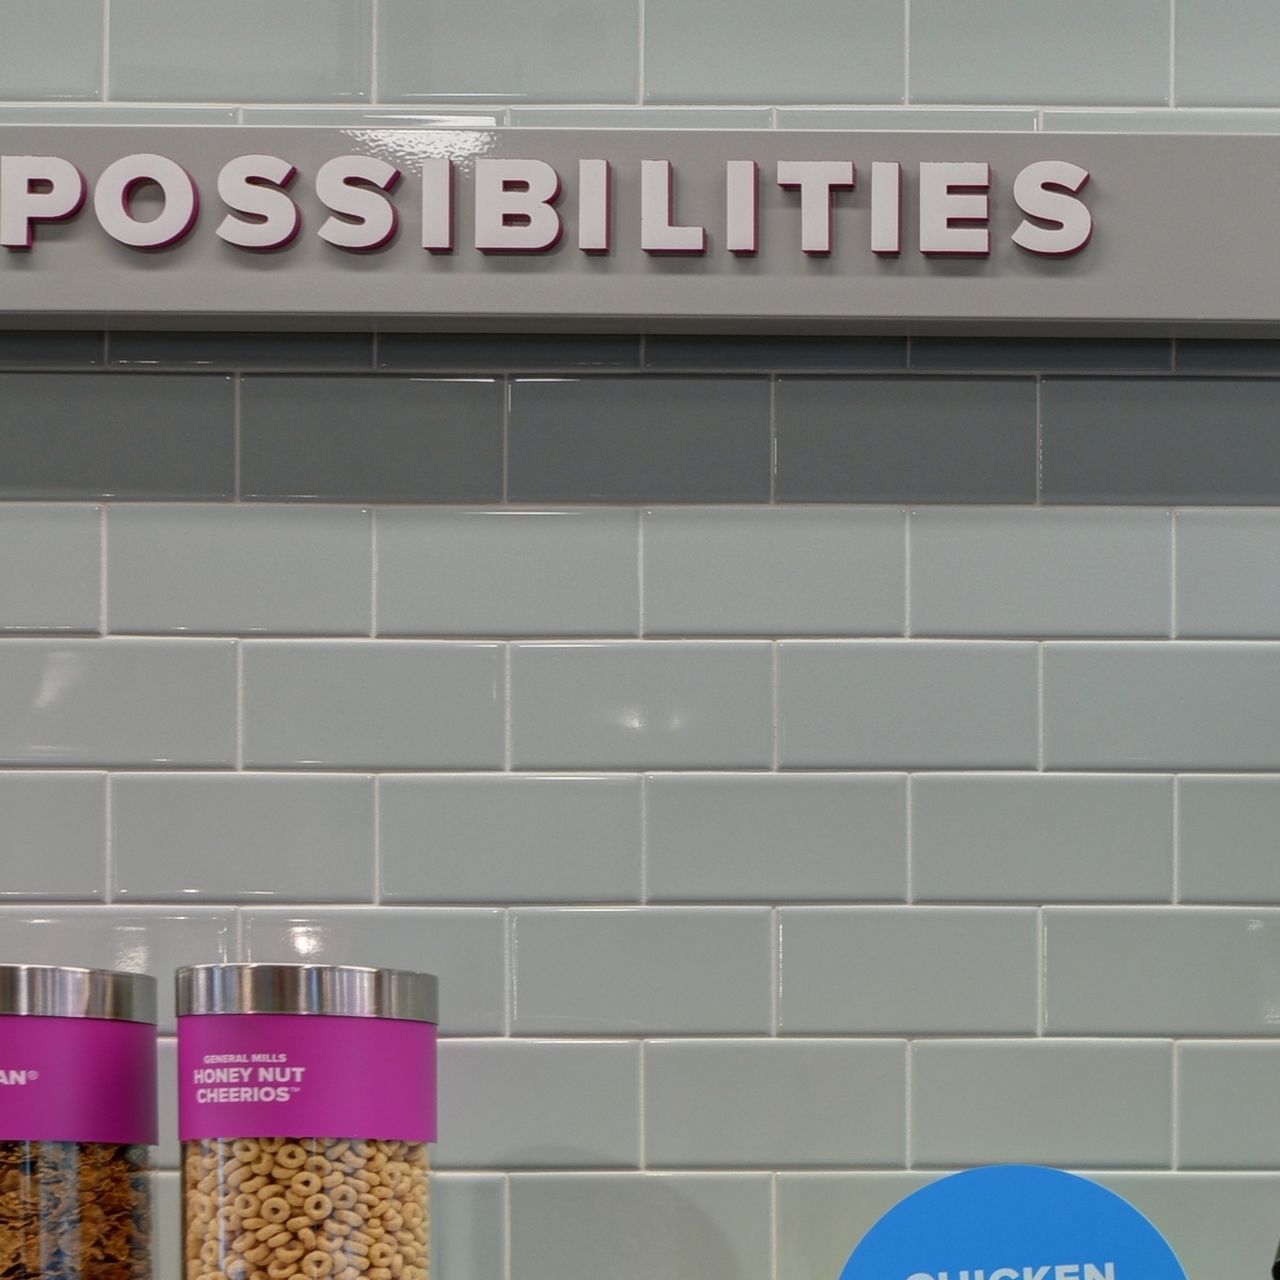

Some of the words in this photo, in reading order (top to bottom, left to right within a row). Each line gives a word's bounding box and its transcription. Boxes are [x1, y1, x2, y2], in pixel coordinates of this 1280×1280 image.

[0, 152, 1095, 257] POSSIBILITIES
[204, 1055, 249, 1064] GENERAL
[252, 1054, 287, 1062] MILLS
[194, 1067, 253, 1084] HONEY
[258, 1067, 305, 1082] NUT
